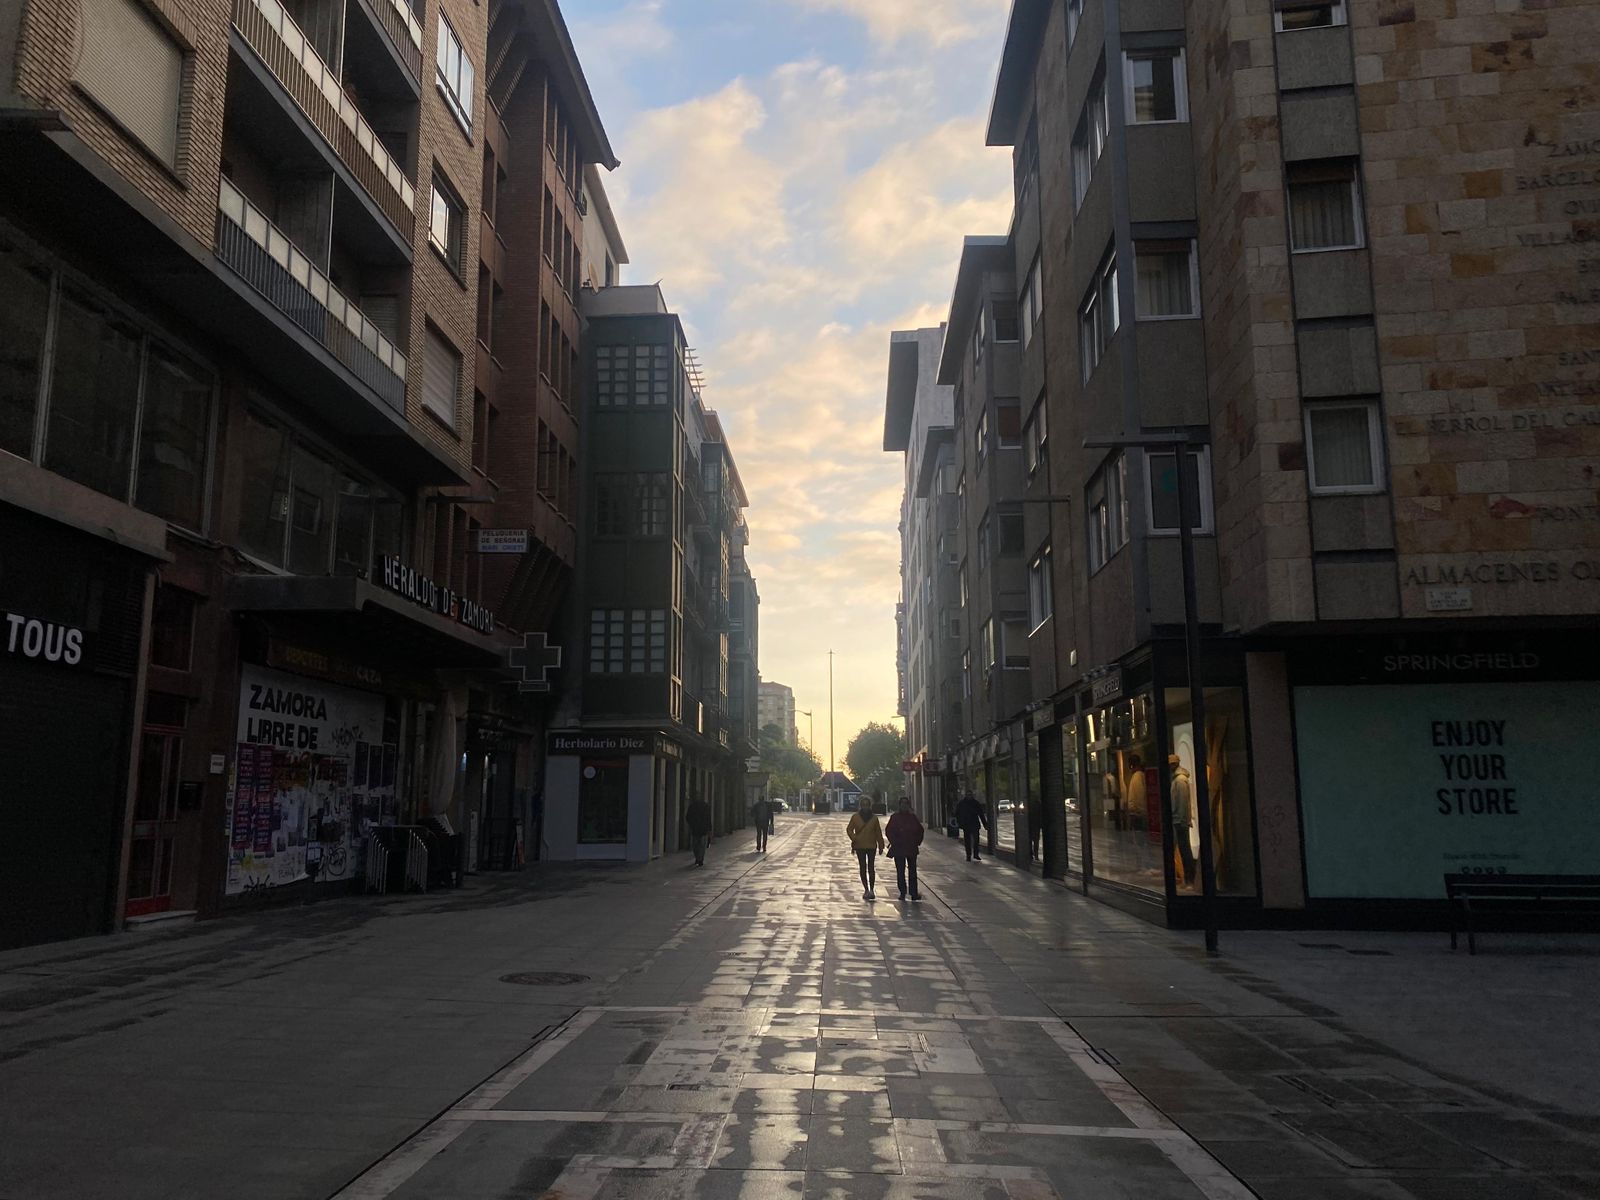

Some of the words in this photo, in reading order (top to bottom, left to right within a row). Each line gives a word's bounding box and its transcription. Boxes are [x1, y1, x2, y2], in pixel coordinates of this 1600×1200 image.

[1512, 413, 1553, 429] DEL
[1404, 560, 1560, 585] ALMACENES
[443, 587, 457, 617] DE
[6, 613, 84, 666] TOUS
[1383, 652, 1540, 672] SPRINGFIELD
[250, 684, 327, 721] ZAMORA
[247, 717, 294, 747] LIBRE
[297, 726, 319, 750] DE
[555, 738, 616, 749] Herbolario
[1431, 720, 1505, 746] ENJOY
[1440, 754, 1507, 780] YOUR
[1437, 788, 1518, 815] STORE
